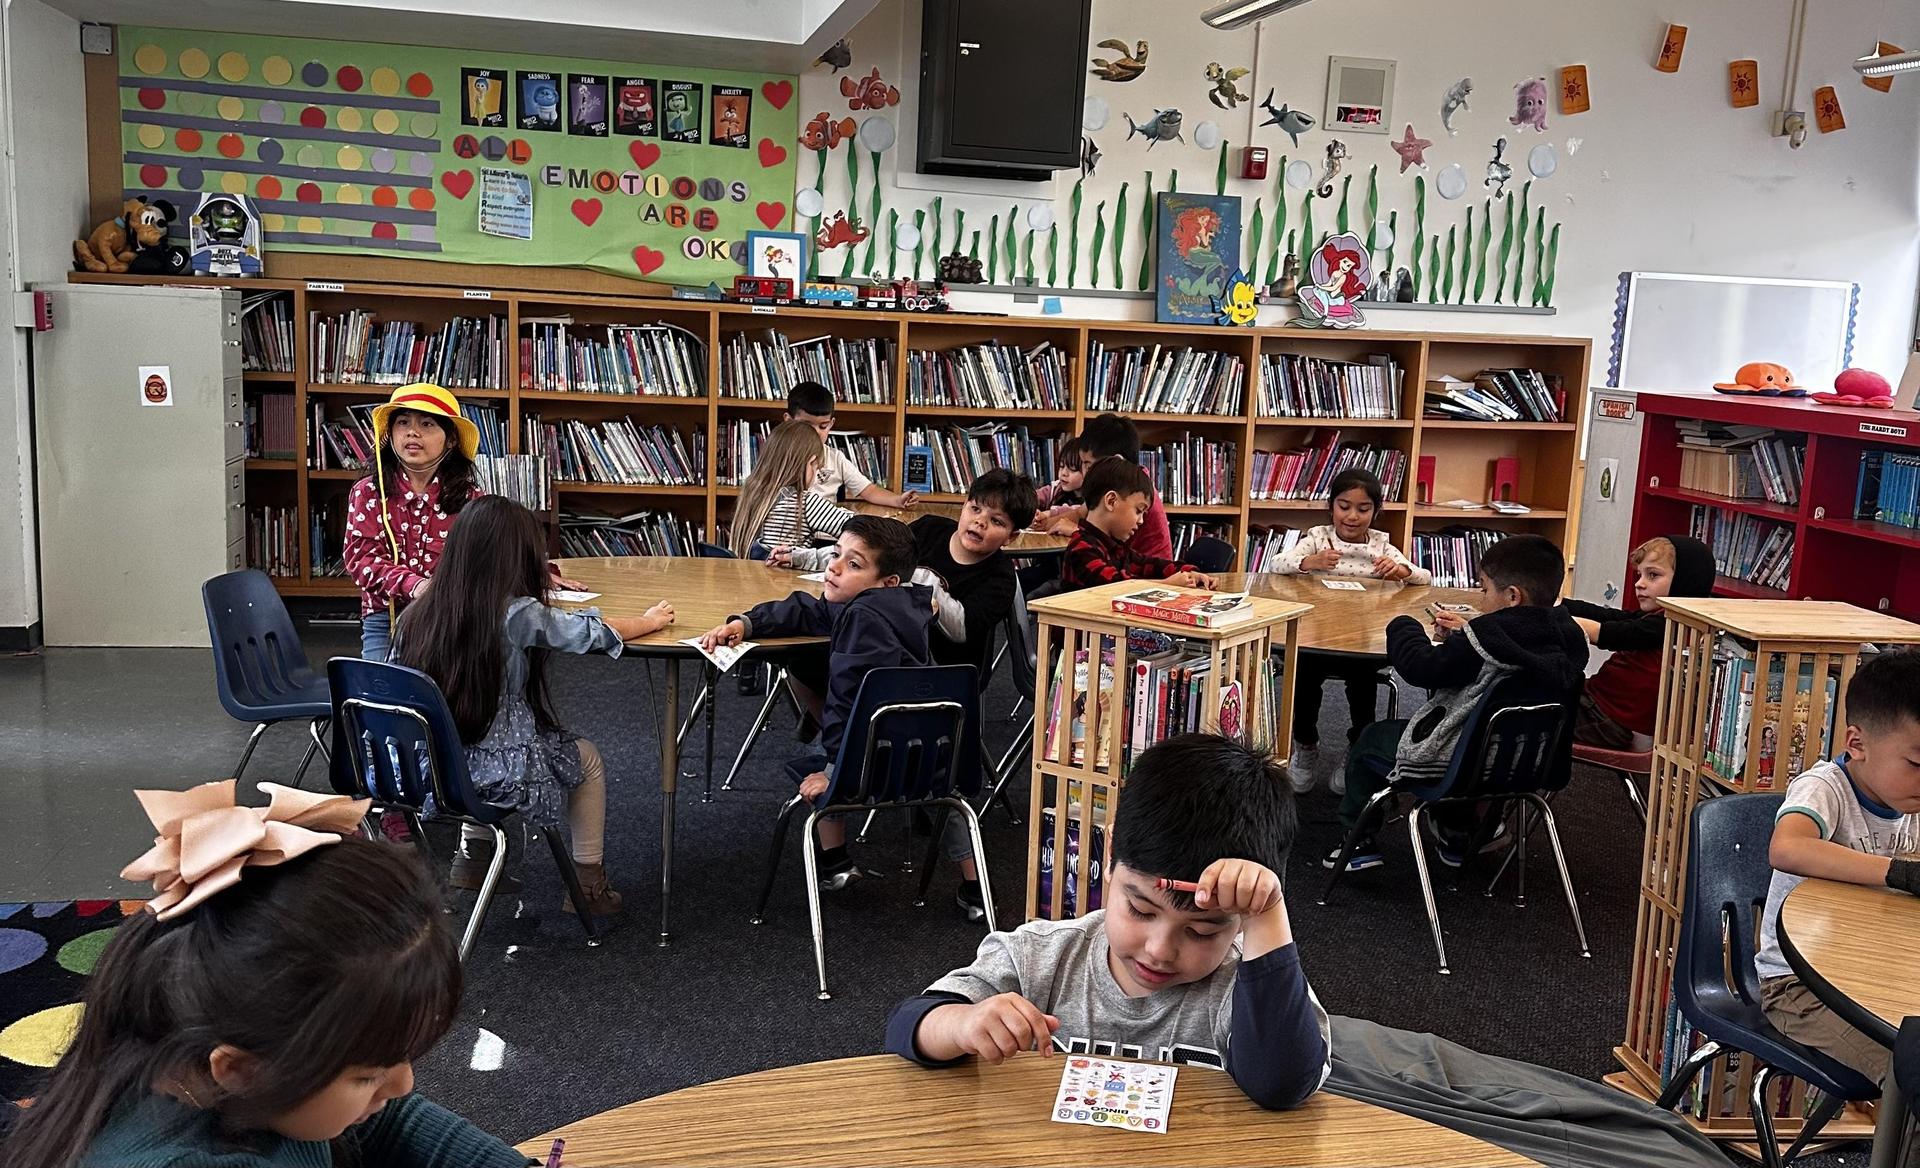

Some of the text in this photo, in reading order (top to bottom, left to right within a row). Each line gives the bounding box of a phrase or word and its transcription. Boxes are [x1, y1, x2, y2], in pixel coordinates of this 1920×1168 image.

[581, 76, 595, 84] FEAR
[721, 88, 743, 96] ANXIETY
[456, 134, 528, 161] ALL
[545, 165, 747, 204] EMOTIONS
[643, 203, 714, 231] ARE
[687, 237, 748, 260] OKA
[1871, 425, 1890, 433] HARDY
[1058, 1108, 1161, 1129] EASTER
[1090, 1105, 1129, 1115] BINGO
